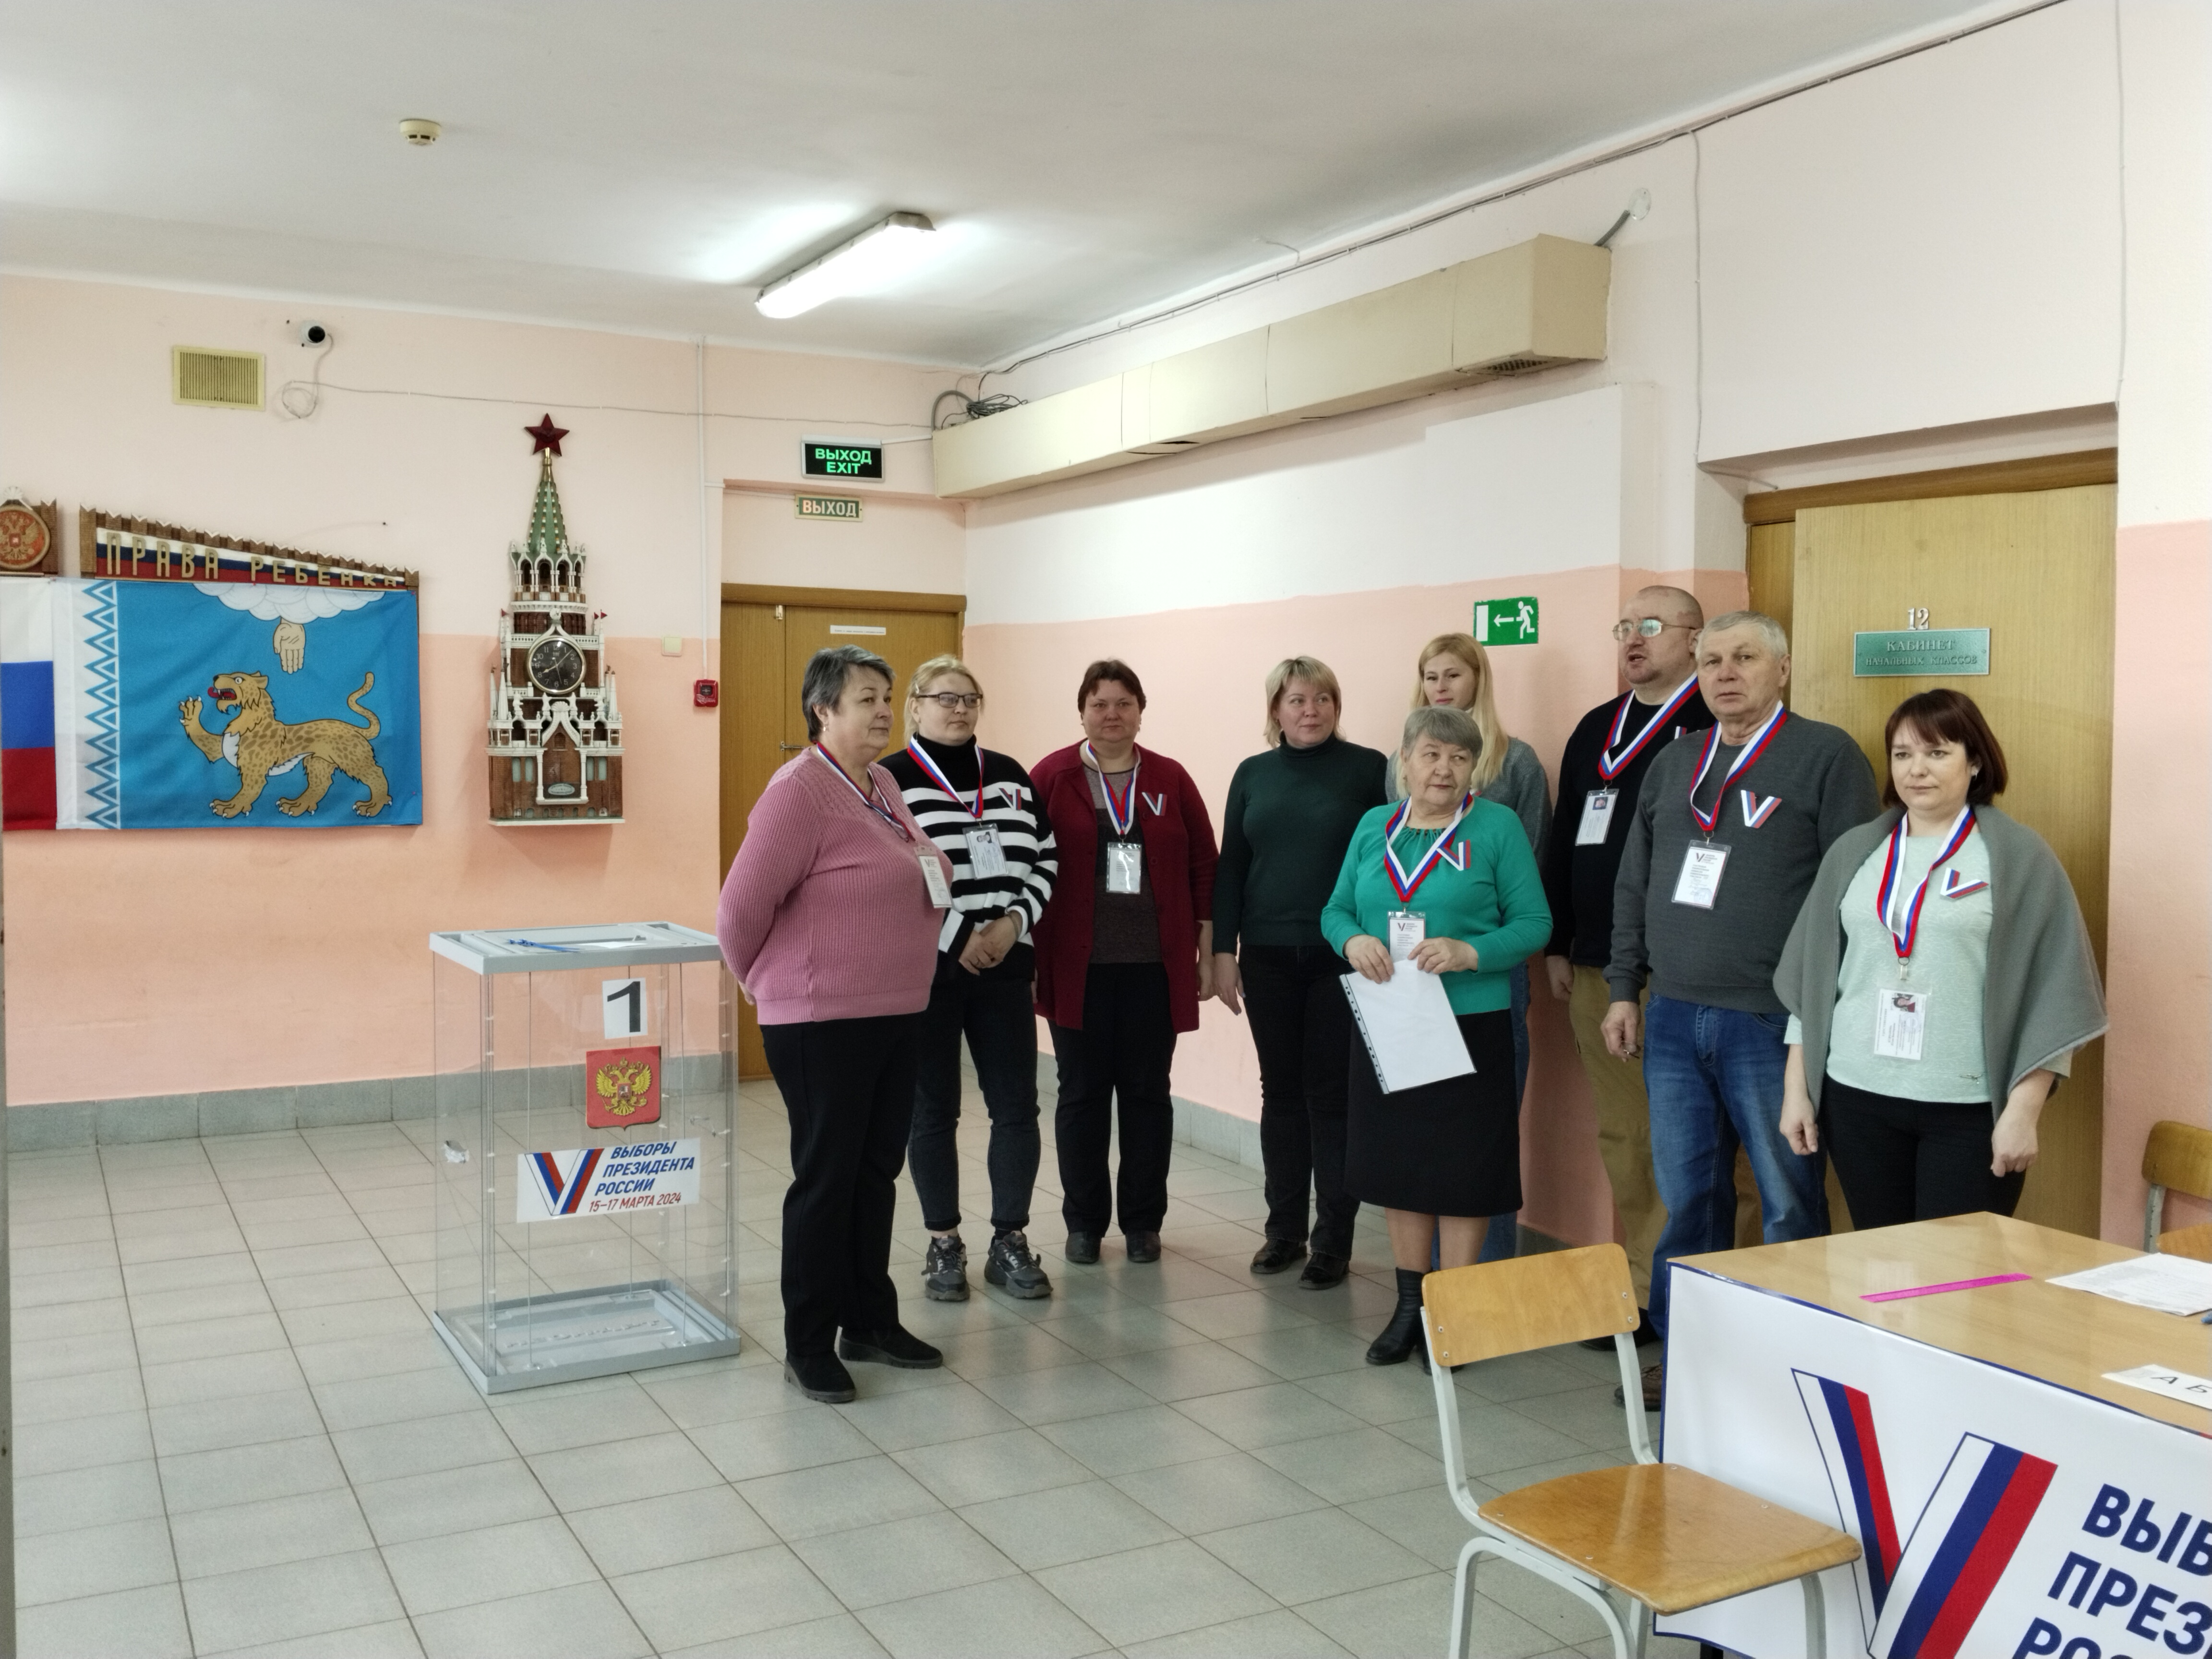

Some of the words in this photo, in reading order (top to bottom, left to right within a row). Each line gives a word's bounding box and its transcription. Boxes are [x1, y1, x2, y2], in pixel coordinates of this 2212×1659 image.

[815, 448, 872, 464] ВЫХОД
[826, 461, 861, 474] EXIT
[802, 499, 857, 517] ВЫХОД
[107, 531, 218, 579] ПРАВА
[1907, 607, 1929, 630] 12
[1887, 639, 1955, 652] КАБИНЕТ
[1865, 656, 1924, 666] НАЧАЛЬНЫХ
[1931, 655, 1977, 665] КЛАССОВ
[607, 981, 641, 1033] 1
[610, 1141, 677, 1159] ВЫБОРЫ
[602, 1157, 695, 1178] ПРЕЗИДЕНТА
[594, 1178, 656, 1196] РОССИИ
[619, 1195, 655, 1210] МАРТА
[656, 1192, 682, 1205] 2024
[2047, 1551, 2212, 1659] ПРЕЗ
